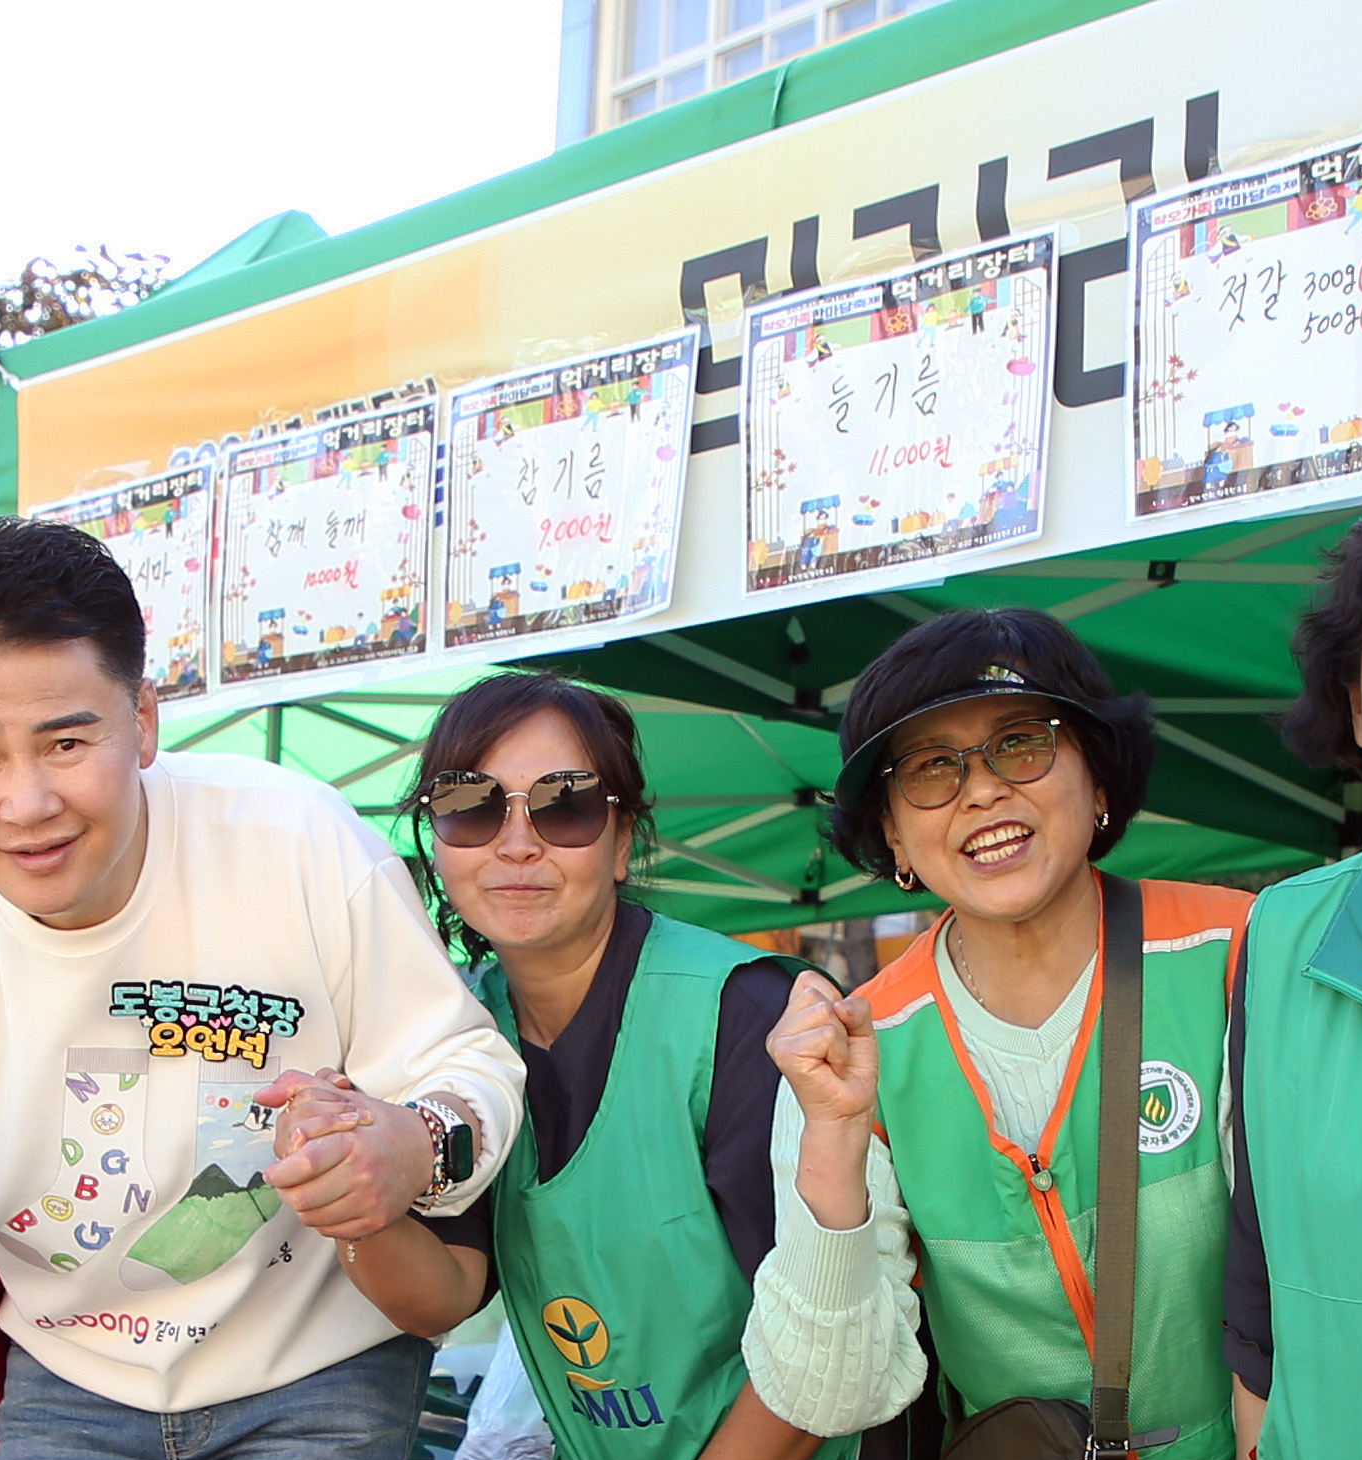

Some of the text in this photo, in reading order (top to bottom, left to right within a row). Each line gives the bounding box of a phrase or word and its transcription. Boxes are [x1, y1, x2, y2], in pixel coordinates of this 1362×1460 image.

[891, 243, 1036, 302] 먹거리장터
[1219, 259, 1288, 332] 젓갈
[560, 341, 683, 389] 먹거리장터
[828, 353, 941, 433] 들기름
[322, 408, 427, 451] 먹거리장터
[517, 441, 606, 506] 참기름
[868, 434, 953, 476] 11.000원
[116, 469, 204, 510] 먹거리장터
[539, 511, 613, 551] 9.000원
[109, 980, 304, 1038] 도봉구청장
[149, 1021, 269, 1069] 오언석
[1140, 1066, 1164, 1076] CTIVE
[1140, 1113, 1195, 1147] 국자율방재단
[61, 1138, 84, 1167] D
[100, 1149, 130, 1175] G
[74, 1174, 100, 1201] B
[122, 1183, 152, 1214] N
[35, 1312, 149, 1344] dobong
[155, 1319, 181, 1344] 같이
